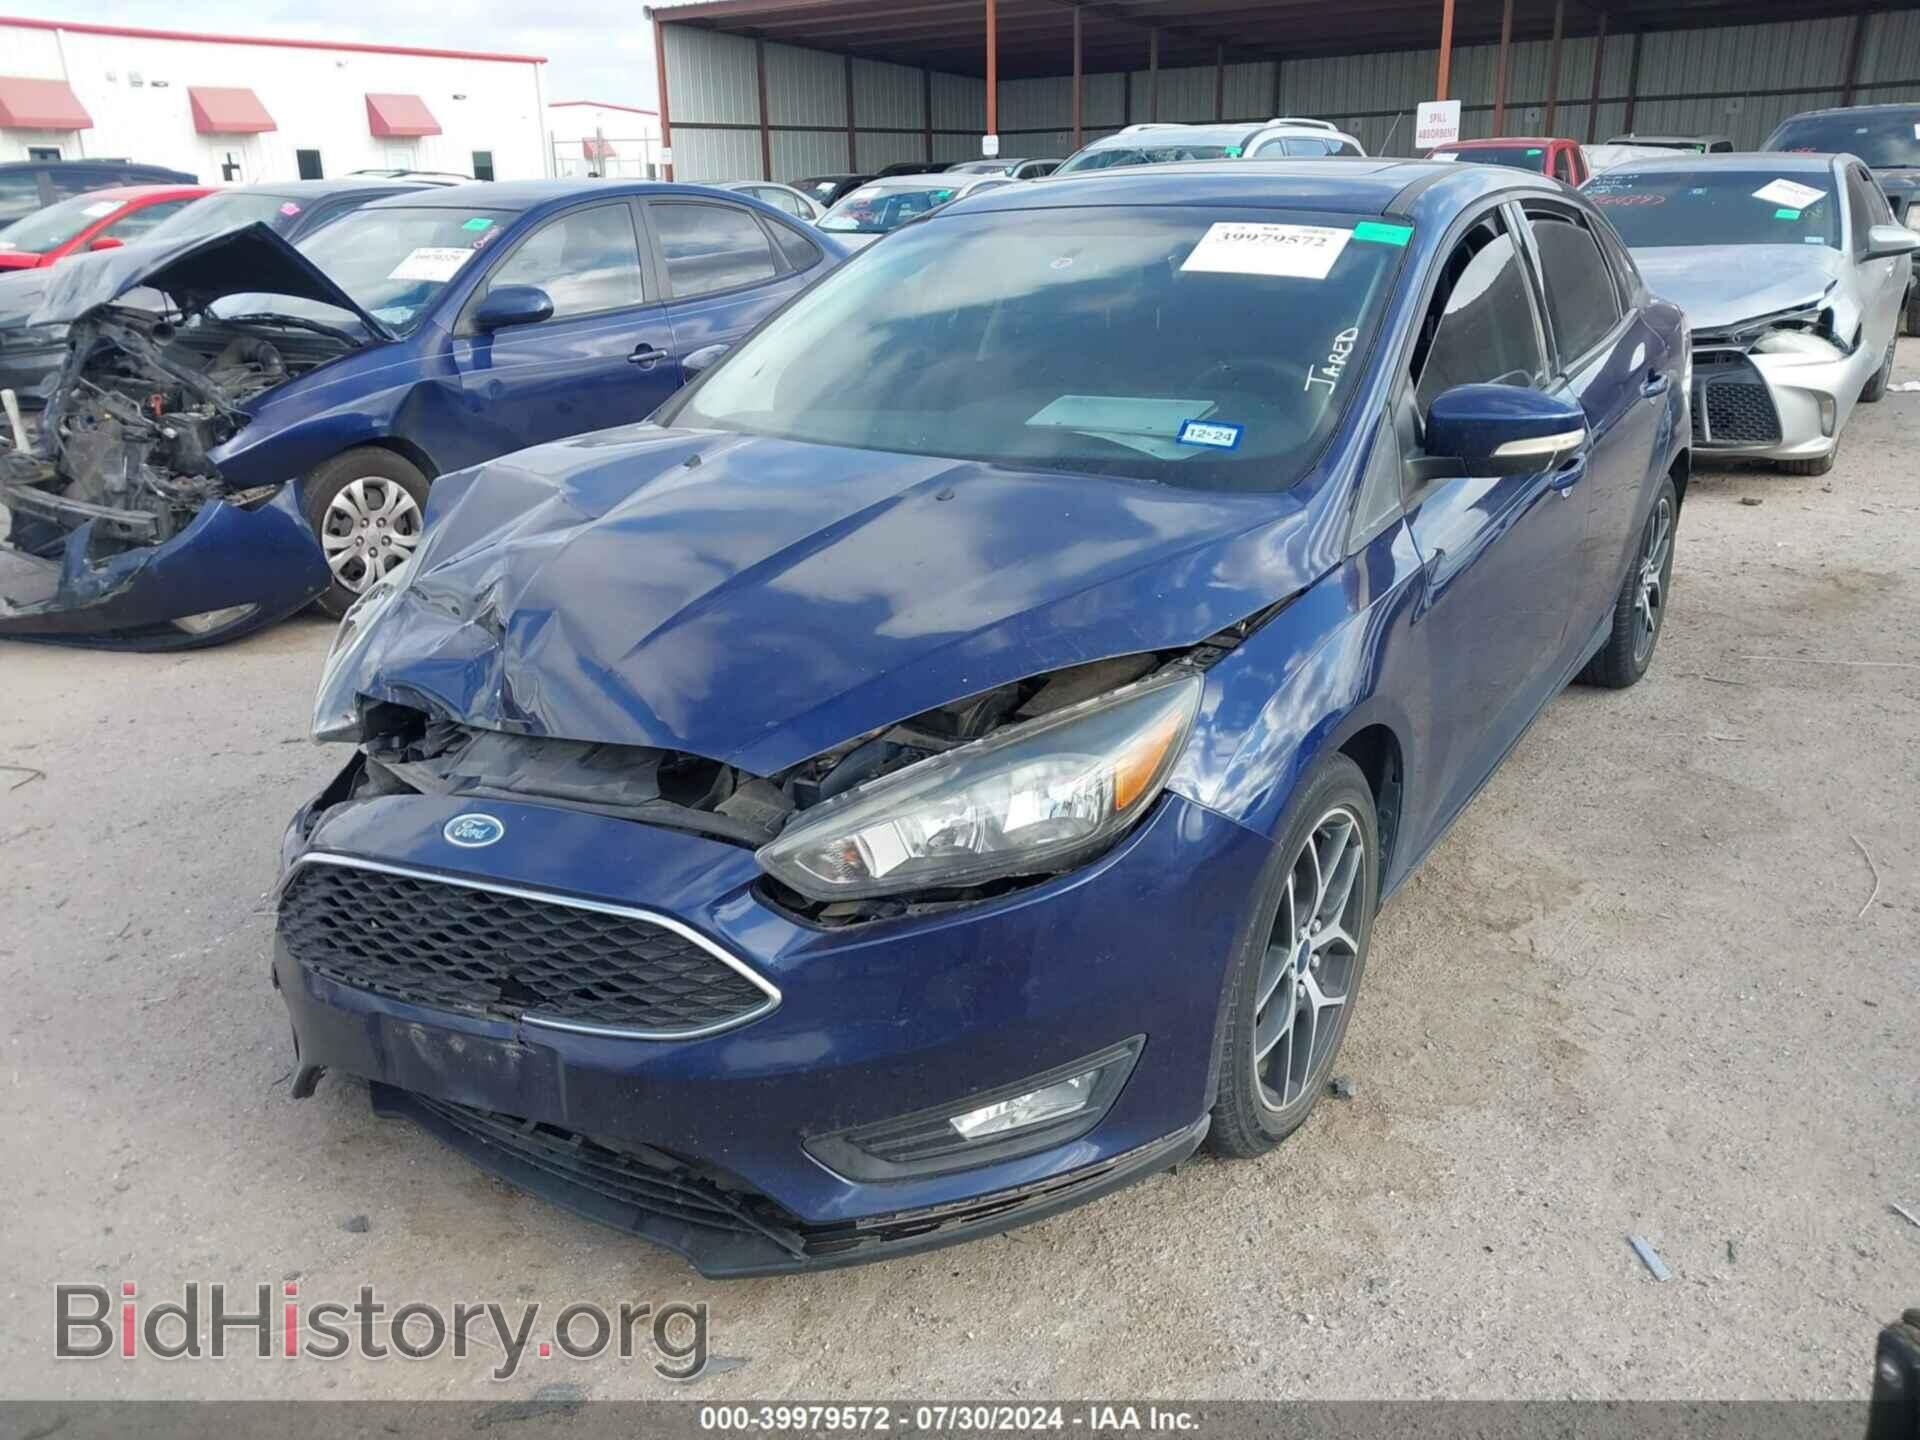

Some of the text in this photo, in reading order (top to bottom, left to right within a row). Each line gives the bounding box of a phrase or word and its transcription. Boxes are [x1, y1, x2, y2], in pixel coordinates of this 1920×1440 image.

[1428, 111, 1448, 124] SPILL
[1216, 231, 1328, 247] 39979572
[1304, 327, 1359, 396] JARED
[455, 819, 491, 840] Ford
